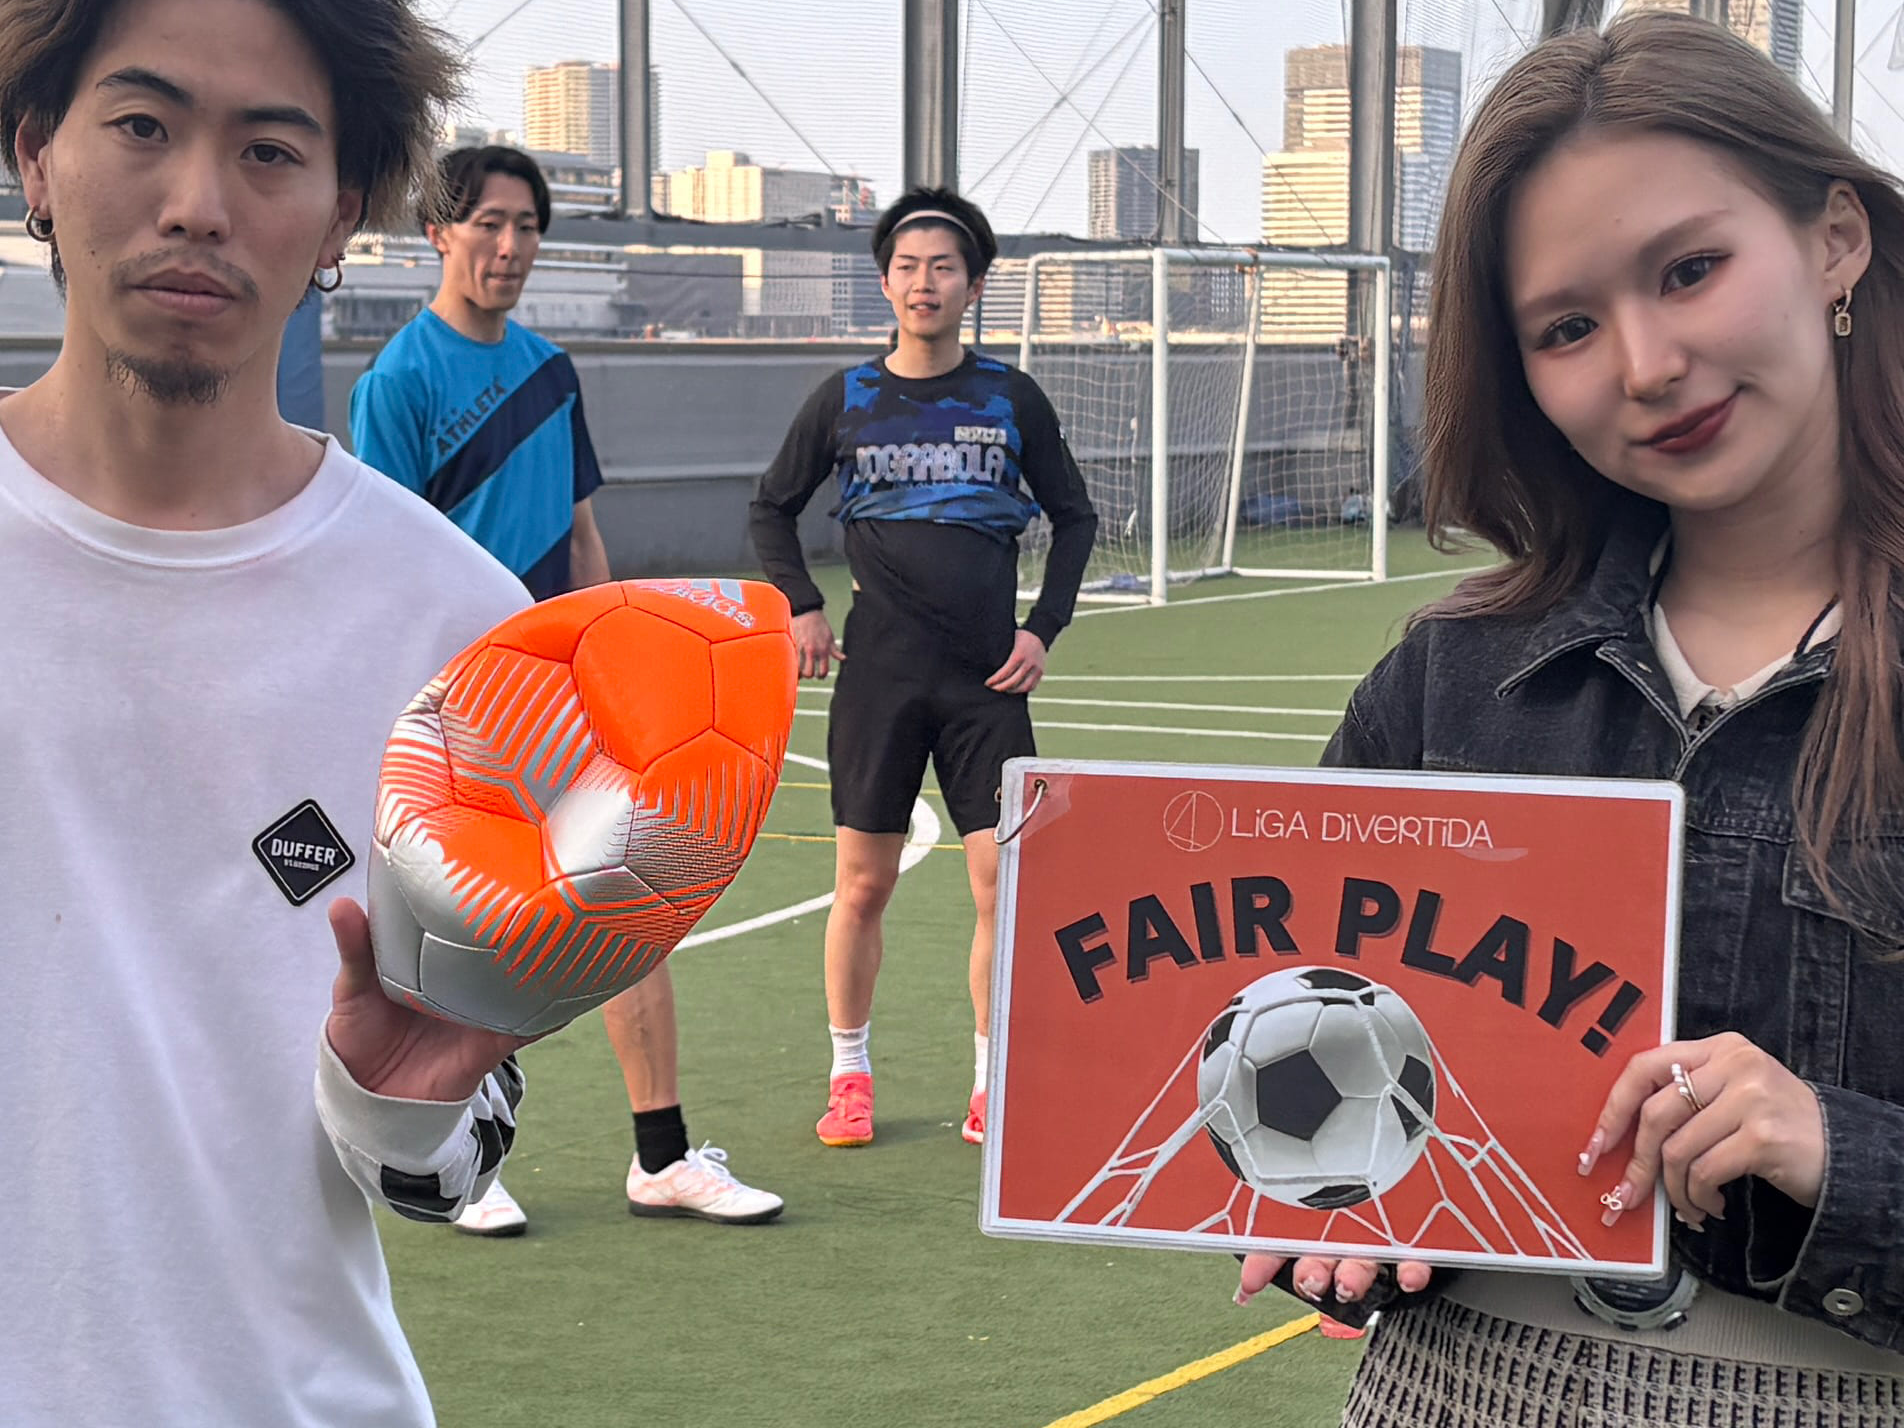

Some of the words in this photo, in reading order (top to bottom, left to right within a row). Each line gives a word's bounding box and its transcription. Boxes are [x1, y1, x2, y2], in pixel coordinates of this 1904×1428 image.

[270, 838, 336, 866] DUFFER
[1053, 875, 1301, 1005] FAIR
[1334, 876, 1645, 1057] PLAY!
